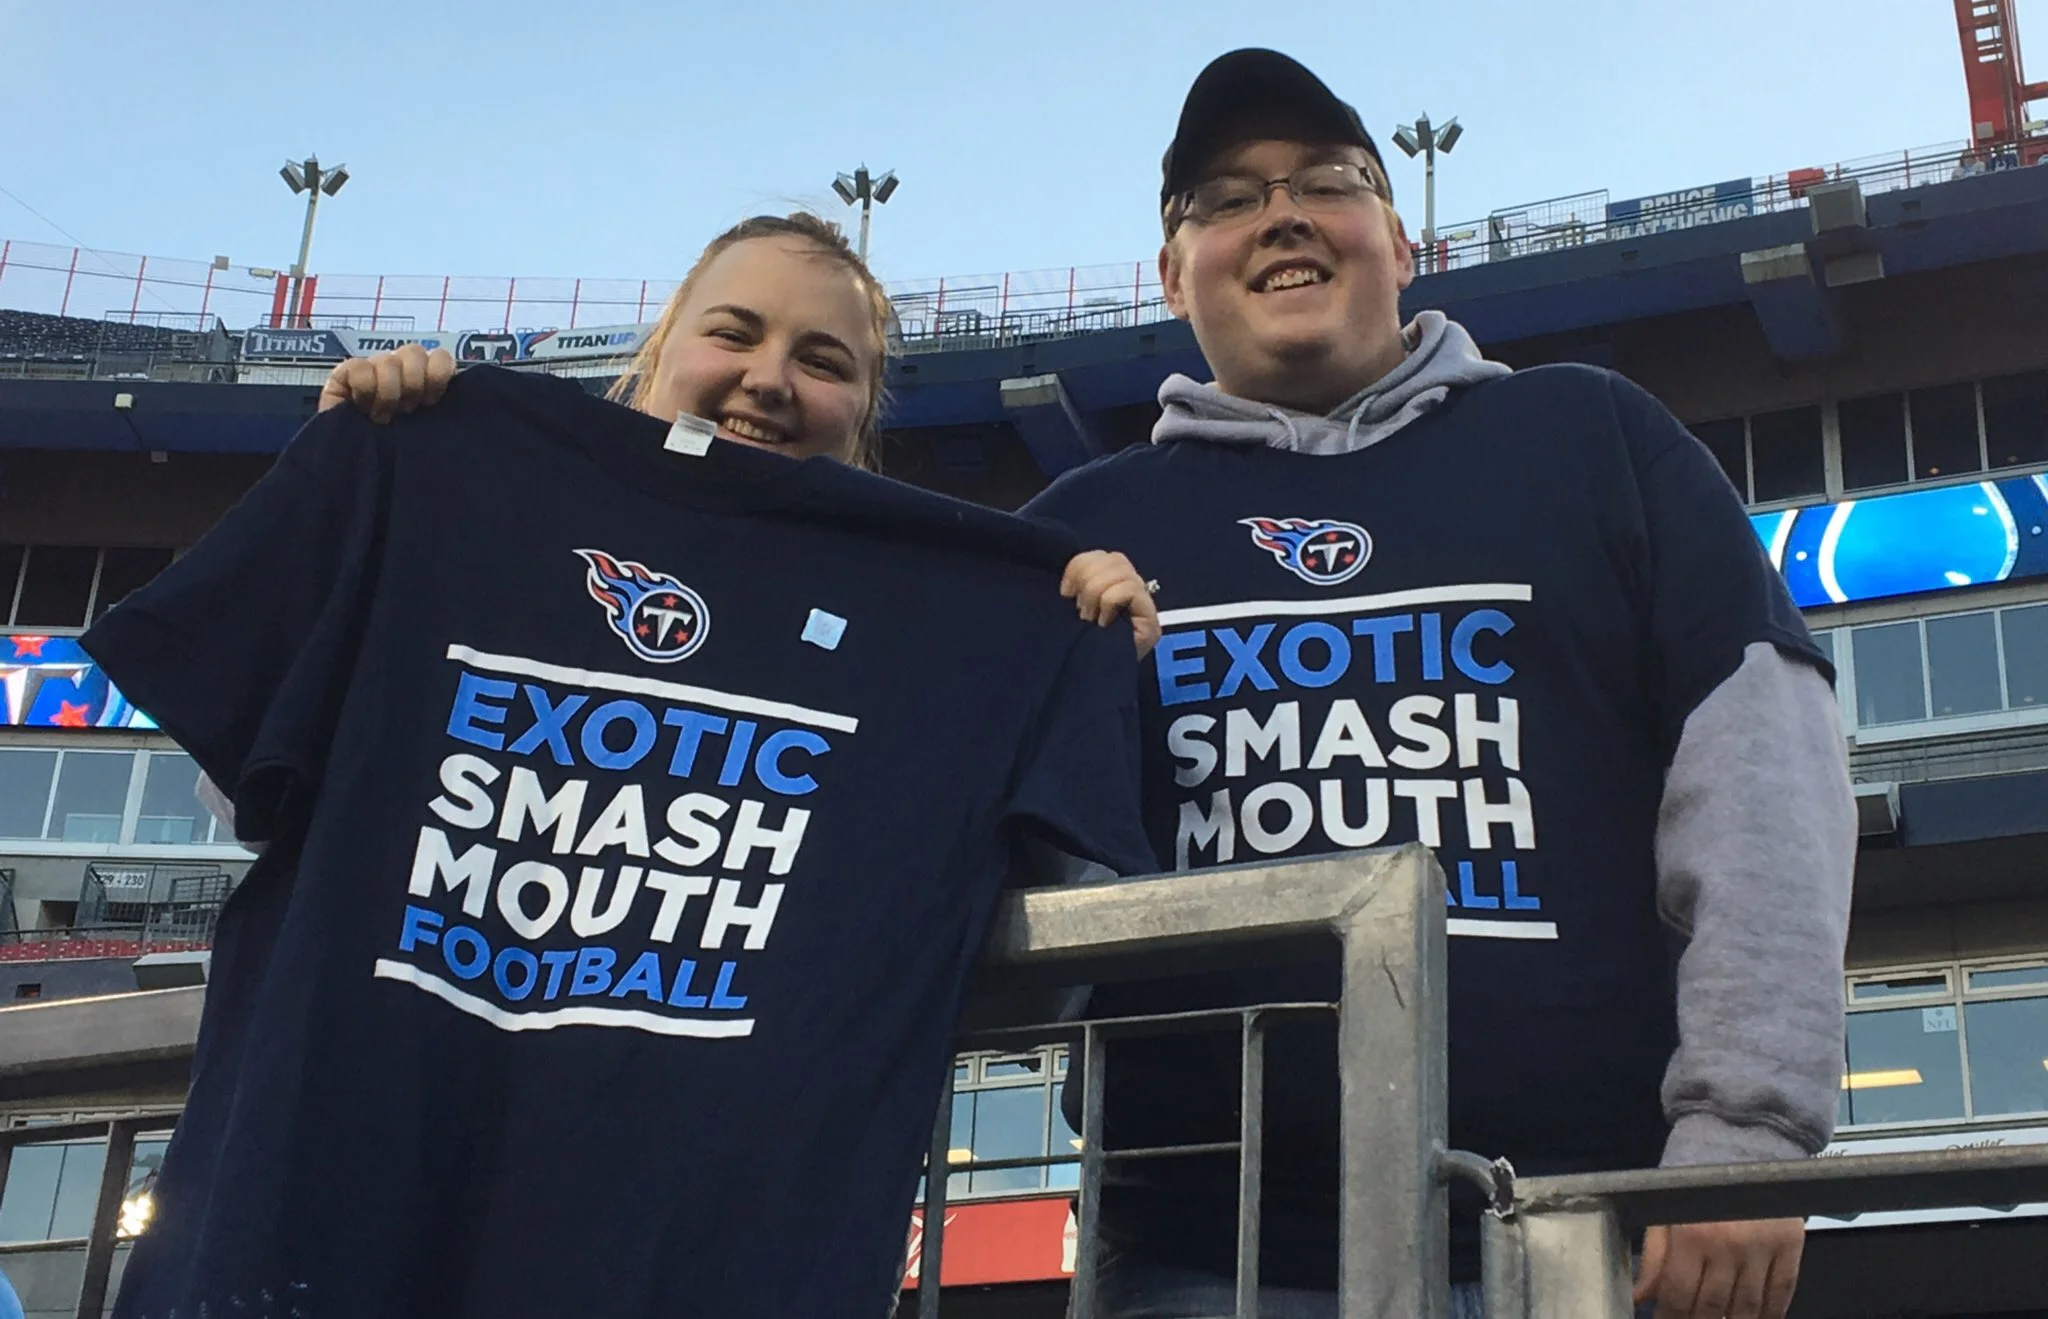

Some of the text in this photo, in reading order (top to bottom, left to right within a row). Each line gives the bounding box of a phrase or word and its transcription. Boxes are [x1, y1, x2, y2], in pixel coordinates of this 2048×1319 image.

[1640, 186, 1716, 221] BRUCE
[250, 331, 326, 353] TITANS
[557, 332, 638, 349] TITANUP
[1154, 609, 1515, 707] EXOTIC
[446, 671, 831, 795] EXOTIC
[1167, 693, 1520, 788] SMASH
[427, 753, 811, 875] SMASH
[1175, 777, 1536, 872] MOUTH
[124, 874, 145, 886] 230
[408, 825, 785, 951] MOUTH
[399, 904, 749, 1010] FOOTBALL
